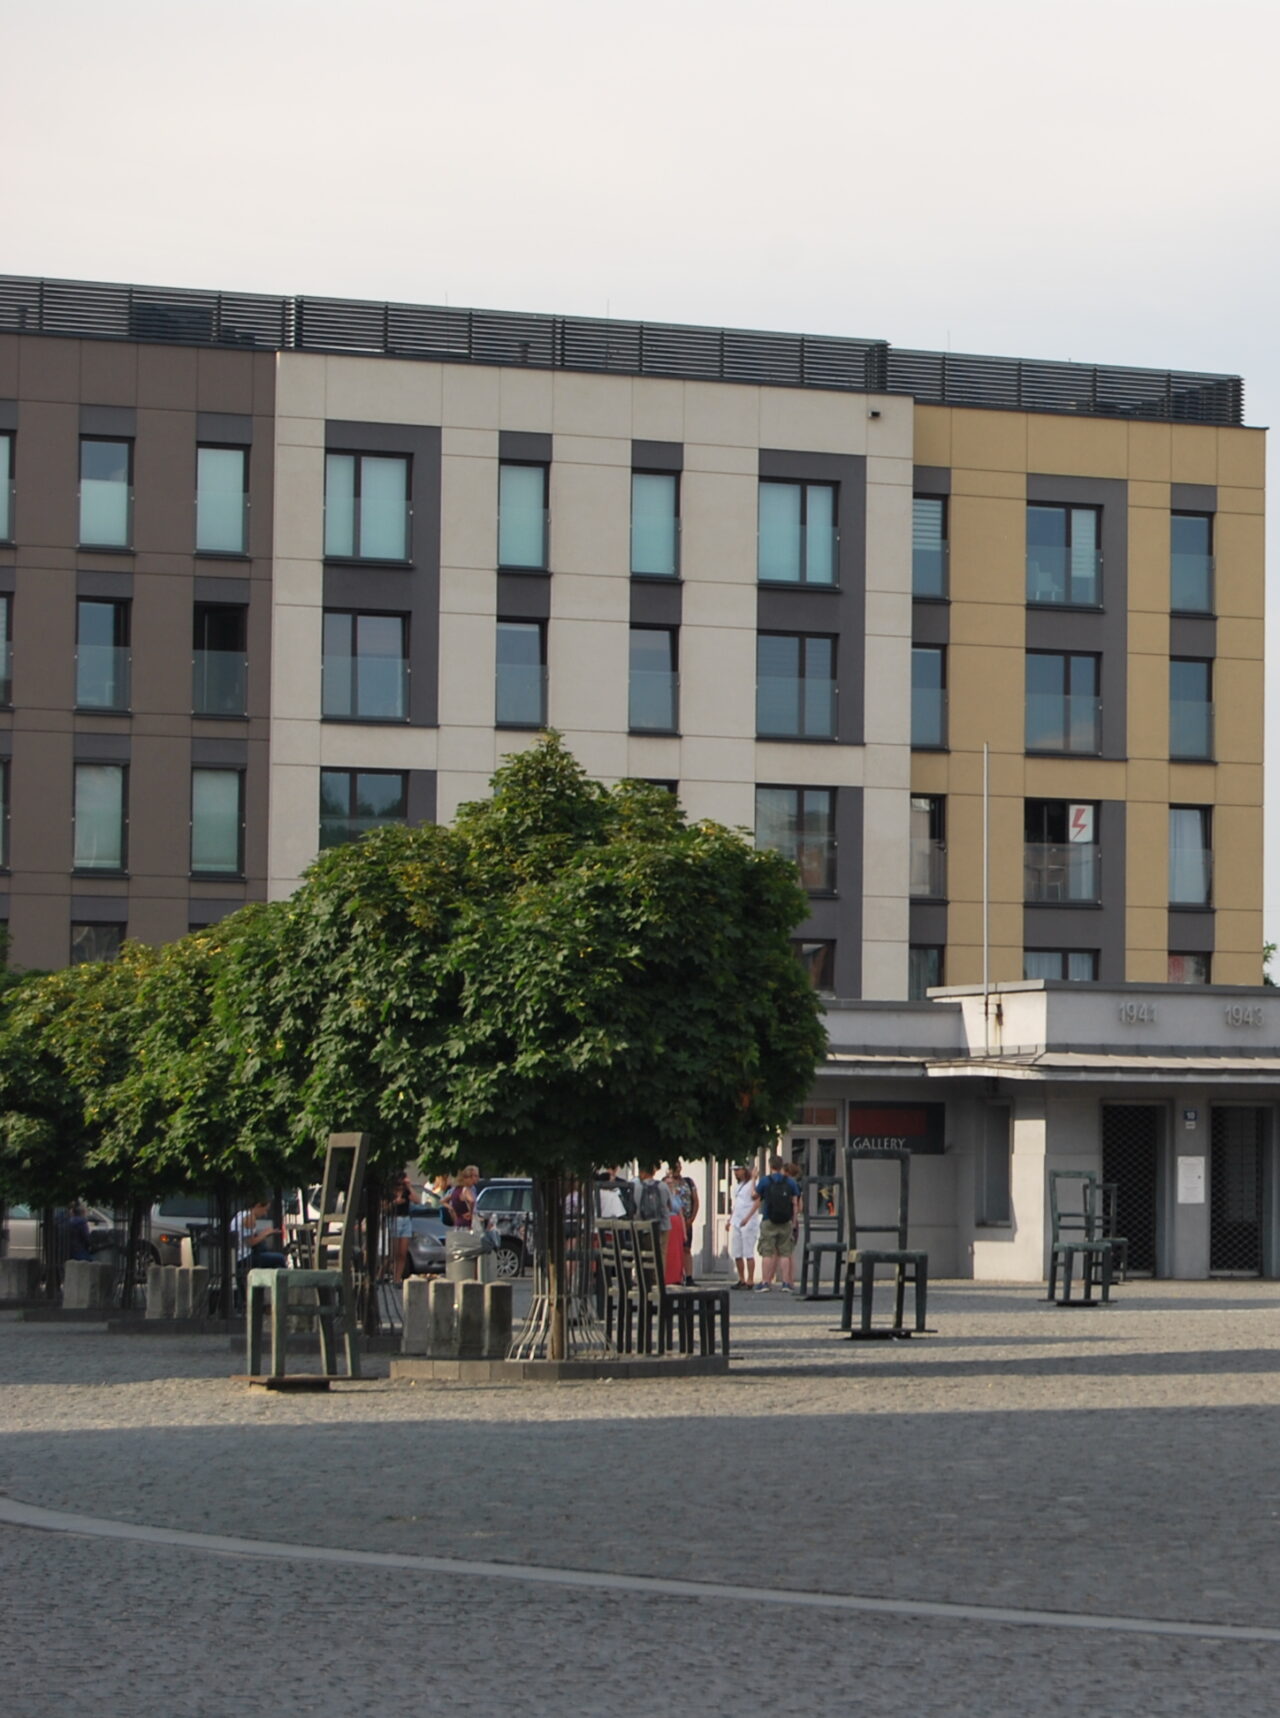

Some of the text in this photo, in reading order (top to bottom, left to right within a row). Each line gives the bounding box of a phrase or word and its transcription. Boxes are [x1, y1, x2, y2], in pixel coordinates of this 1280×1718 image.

[1119, 1001, 1265, 1026] 1941 1943
[852, 1136, 906, 1151] GALLERY
